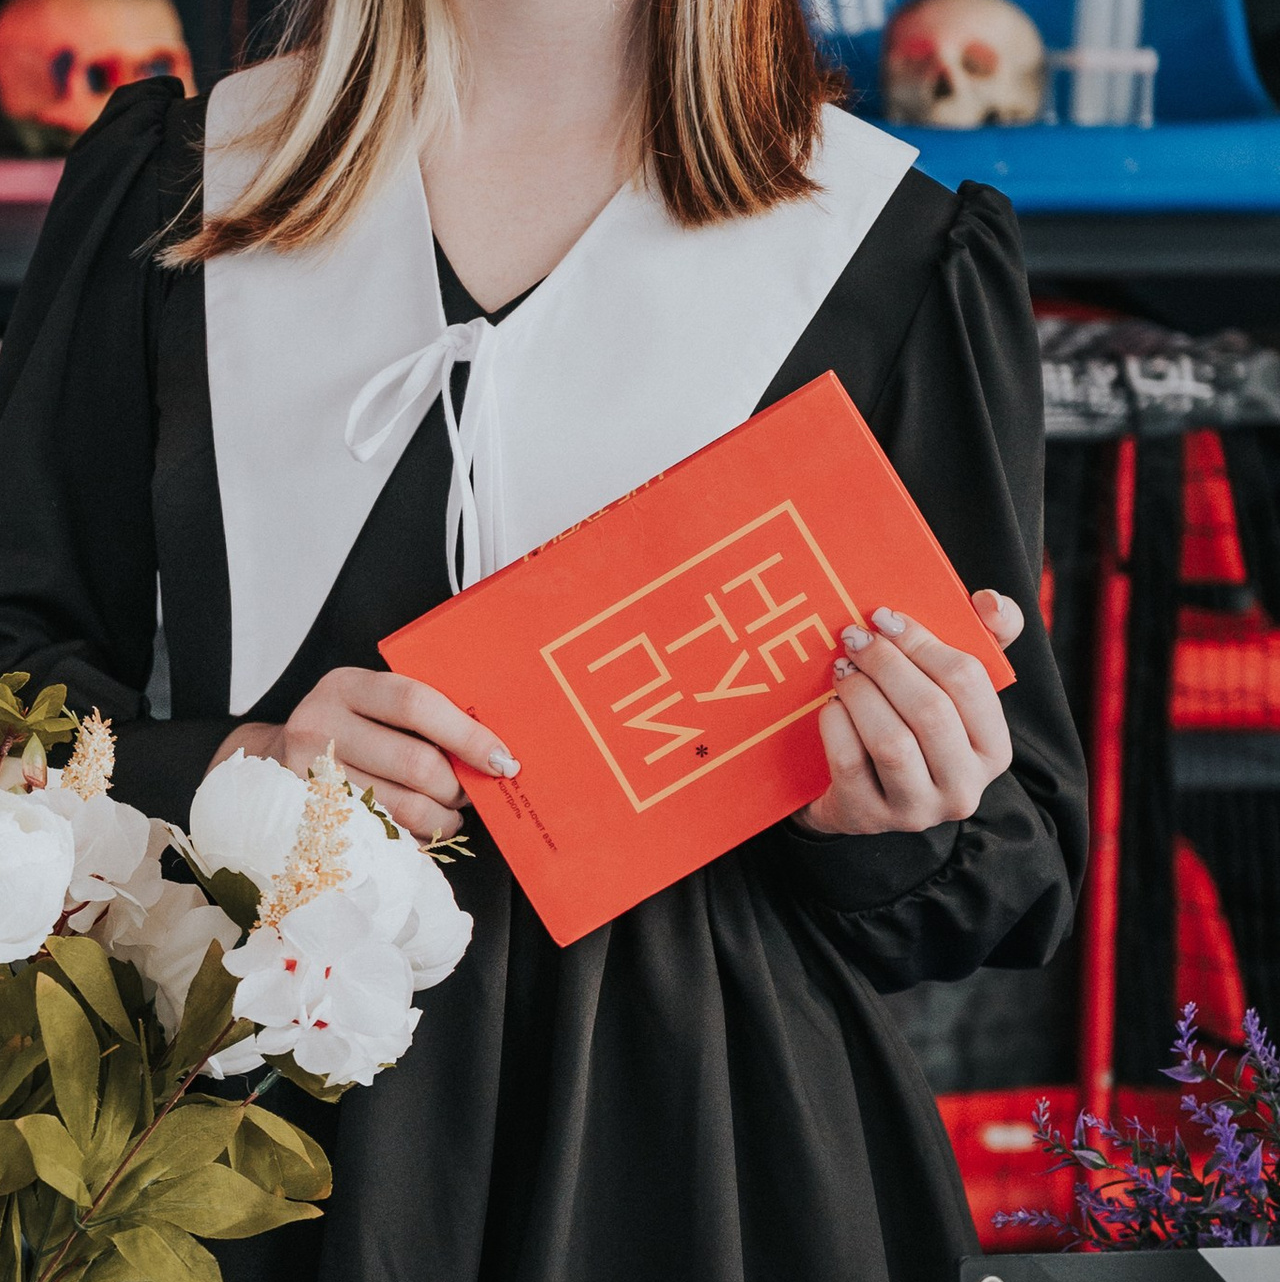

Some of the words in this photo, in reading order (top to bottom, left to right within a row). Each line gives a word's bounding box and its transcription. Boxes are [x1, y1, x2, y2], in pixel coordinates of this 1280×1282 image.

[665, 592, 770, 703] ТУ
[721, 552, 837, 684] НЕ
[520, 794, 531, 808] кто
[542, 833, 557, 852] взят
